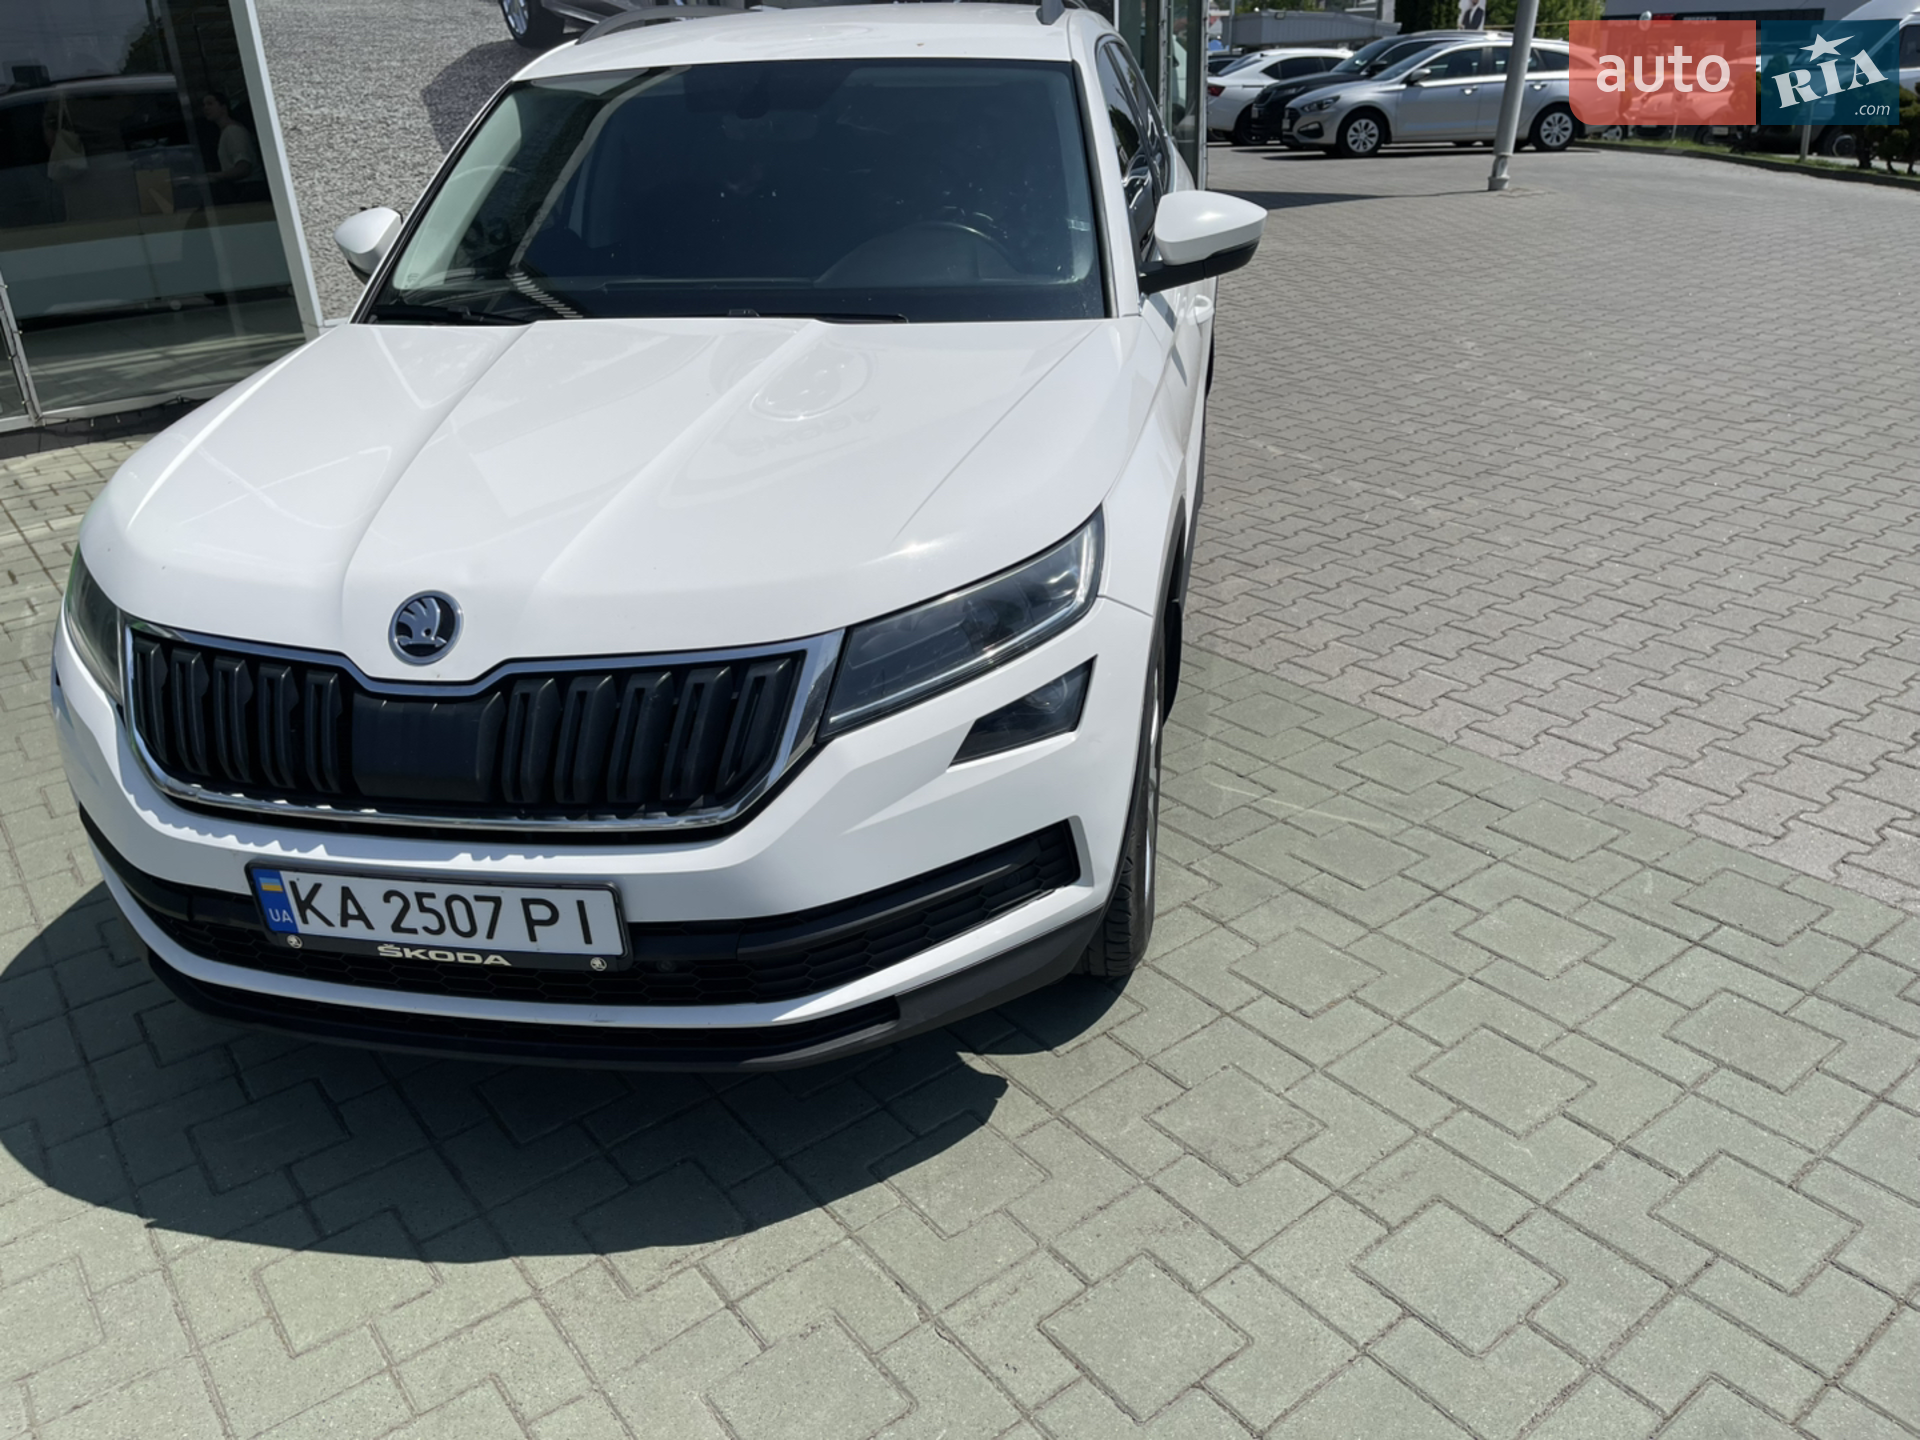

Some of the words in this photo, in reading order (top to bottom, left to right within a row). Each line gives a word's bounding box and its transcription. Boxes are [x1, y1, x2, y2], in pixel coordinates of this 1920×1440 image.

[268, 907, 294, 924] UA
[288, 880, 376, 931] KA
[382, 889, 503, 939] 2507
[520, 897, 594, 945] PI
[377, 943, 512, 967] ŠKODA
